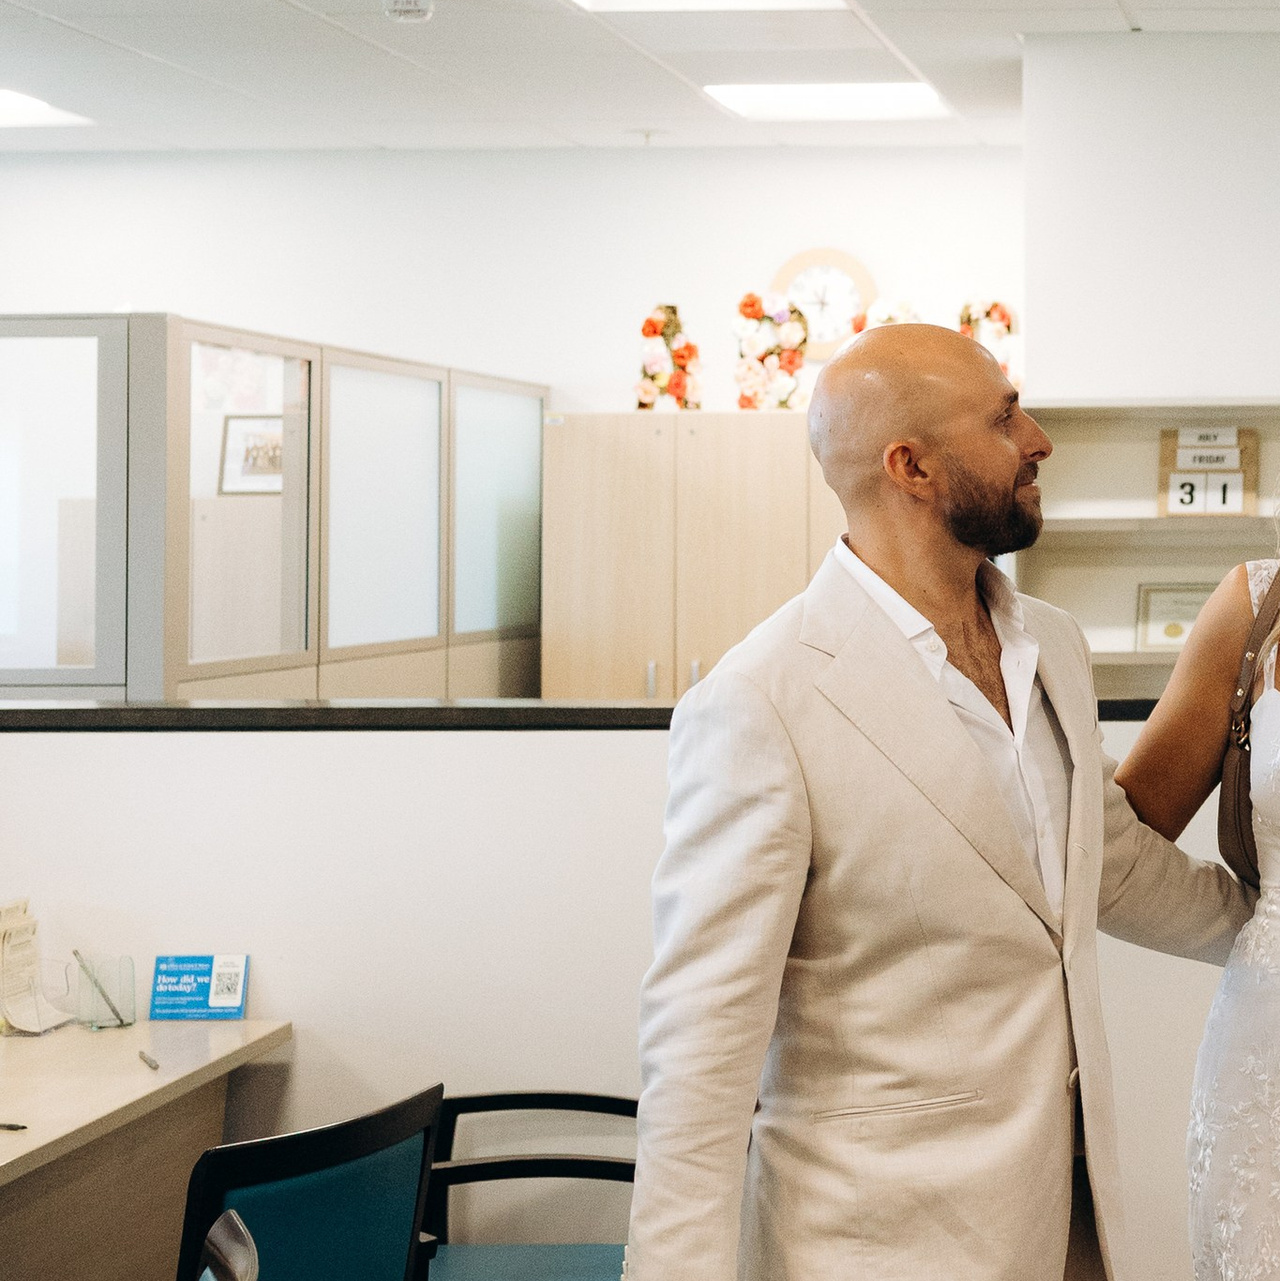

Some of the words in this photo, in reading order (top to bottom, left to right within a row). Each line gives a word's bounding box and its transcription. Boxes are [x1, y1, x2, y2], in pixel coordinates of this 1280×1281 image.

[1192, 454, 1227, 464] FRIDAY
[157, 974, 178, 984] How
[180, 974, 194, 984] did
[196, 975, 210, 984] we
[156, 984, 168, 992] do
[168, 983, 197, 993] today?
